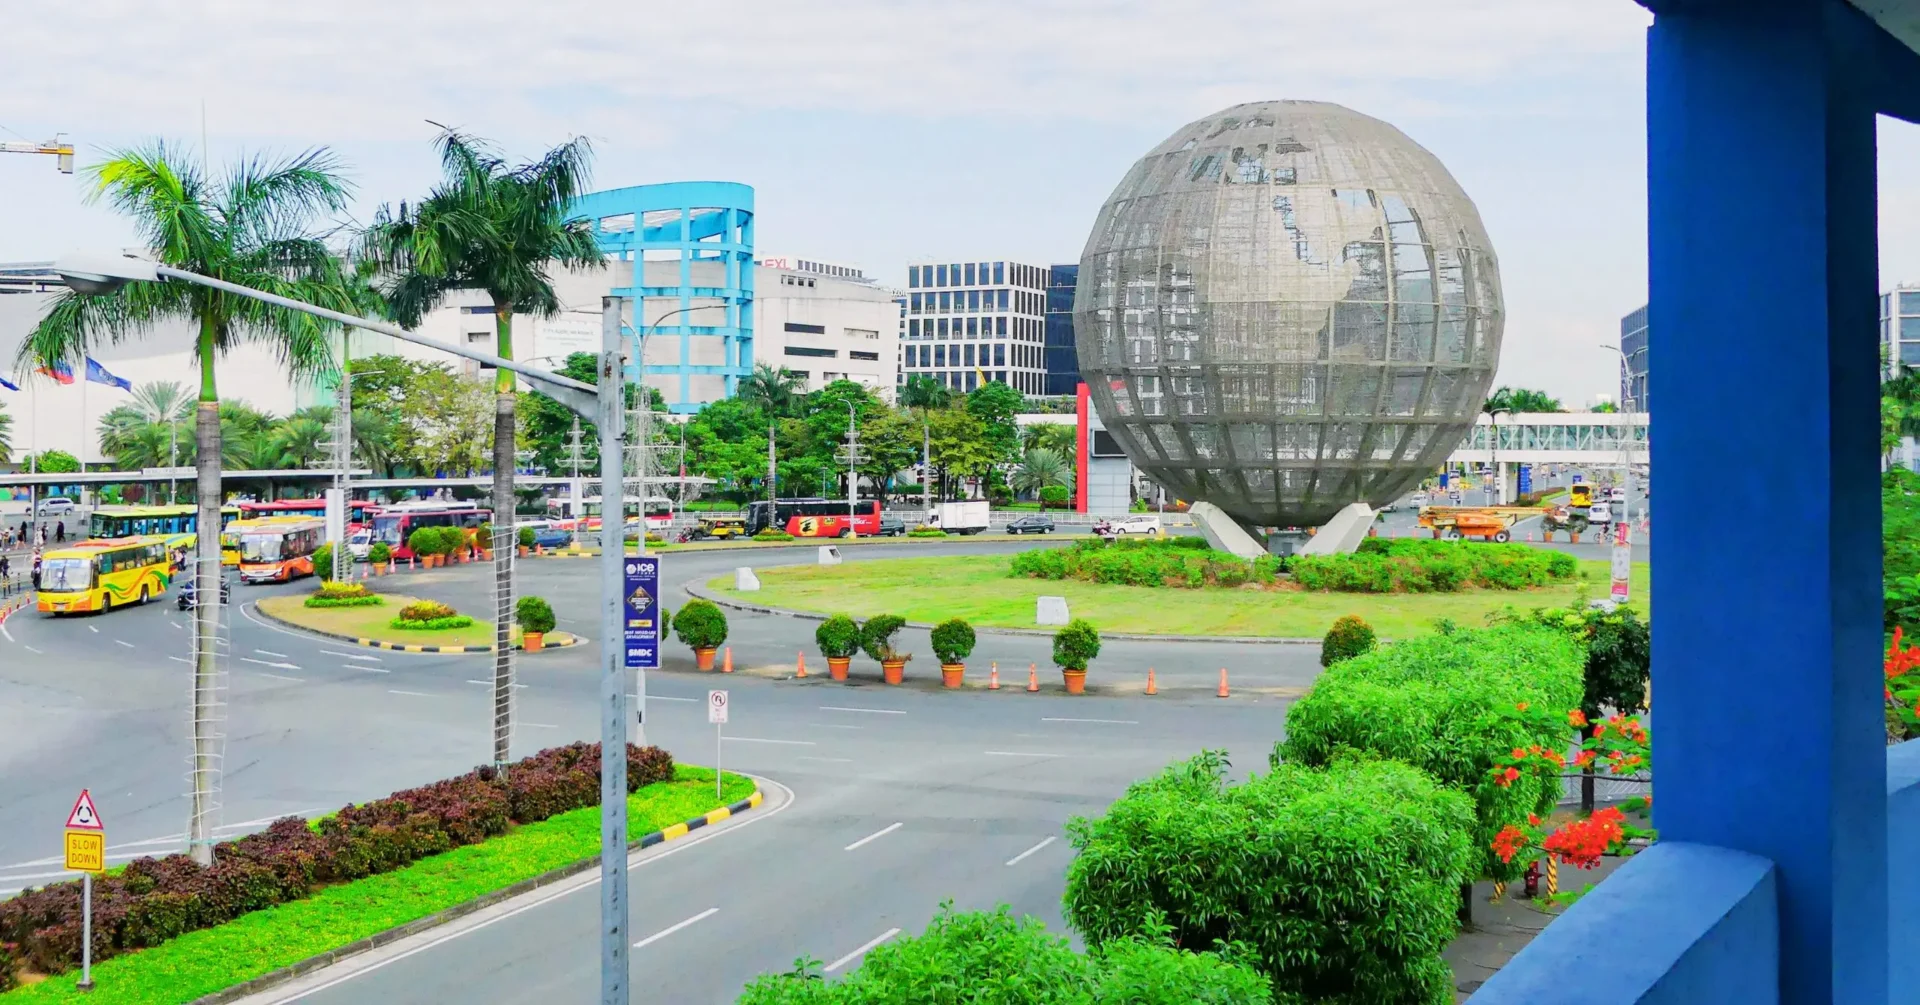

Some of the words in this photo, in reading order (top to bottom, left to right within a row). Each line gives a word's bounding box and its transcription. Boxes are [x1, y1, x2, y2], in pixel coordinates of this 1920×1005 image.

[628, 648, 652, 657] SMDC
[72, 839, 98, 850] SLOW
[72, 853, 98, 864] DOWN
